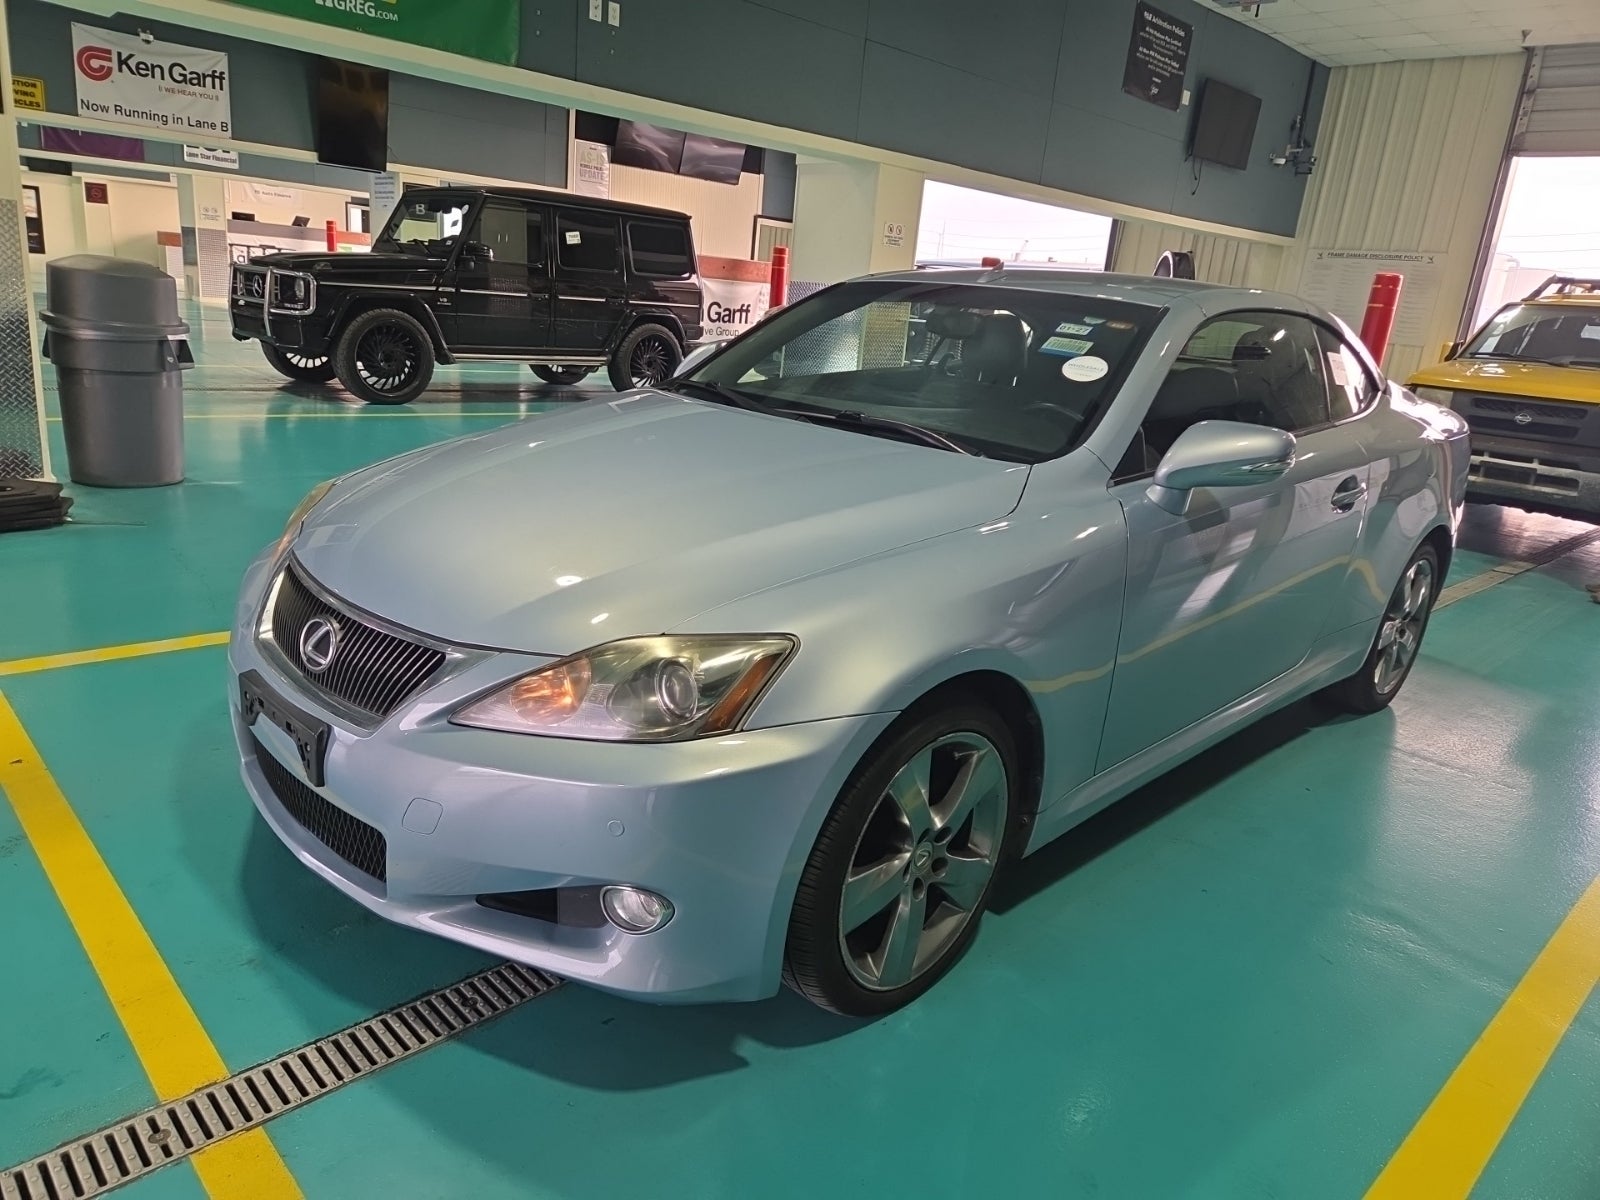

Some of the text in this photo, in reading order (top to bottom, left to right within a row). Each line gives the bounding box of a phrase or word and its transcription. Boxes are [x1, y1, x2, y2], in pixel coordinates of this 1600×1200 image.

[117, 51, 226, 91] Ken Garff
[164, 86, 214, 101] WE HEAR YOU
[80, 98, 229, 133] Now Running in Lane B
[200, 152, 211, 160] Star
[212, 153, 237, 164] Financial
[580, 168, 606, 180] UPDATE
[416, 203, 425, 215] B
[707, 301, 751, 324] Garff
[716, 327, 740, 337] Group
